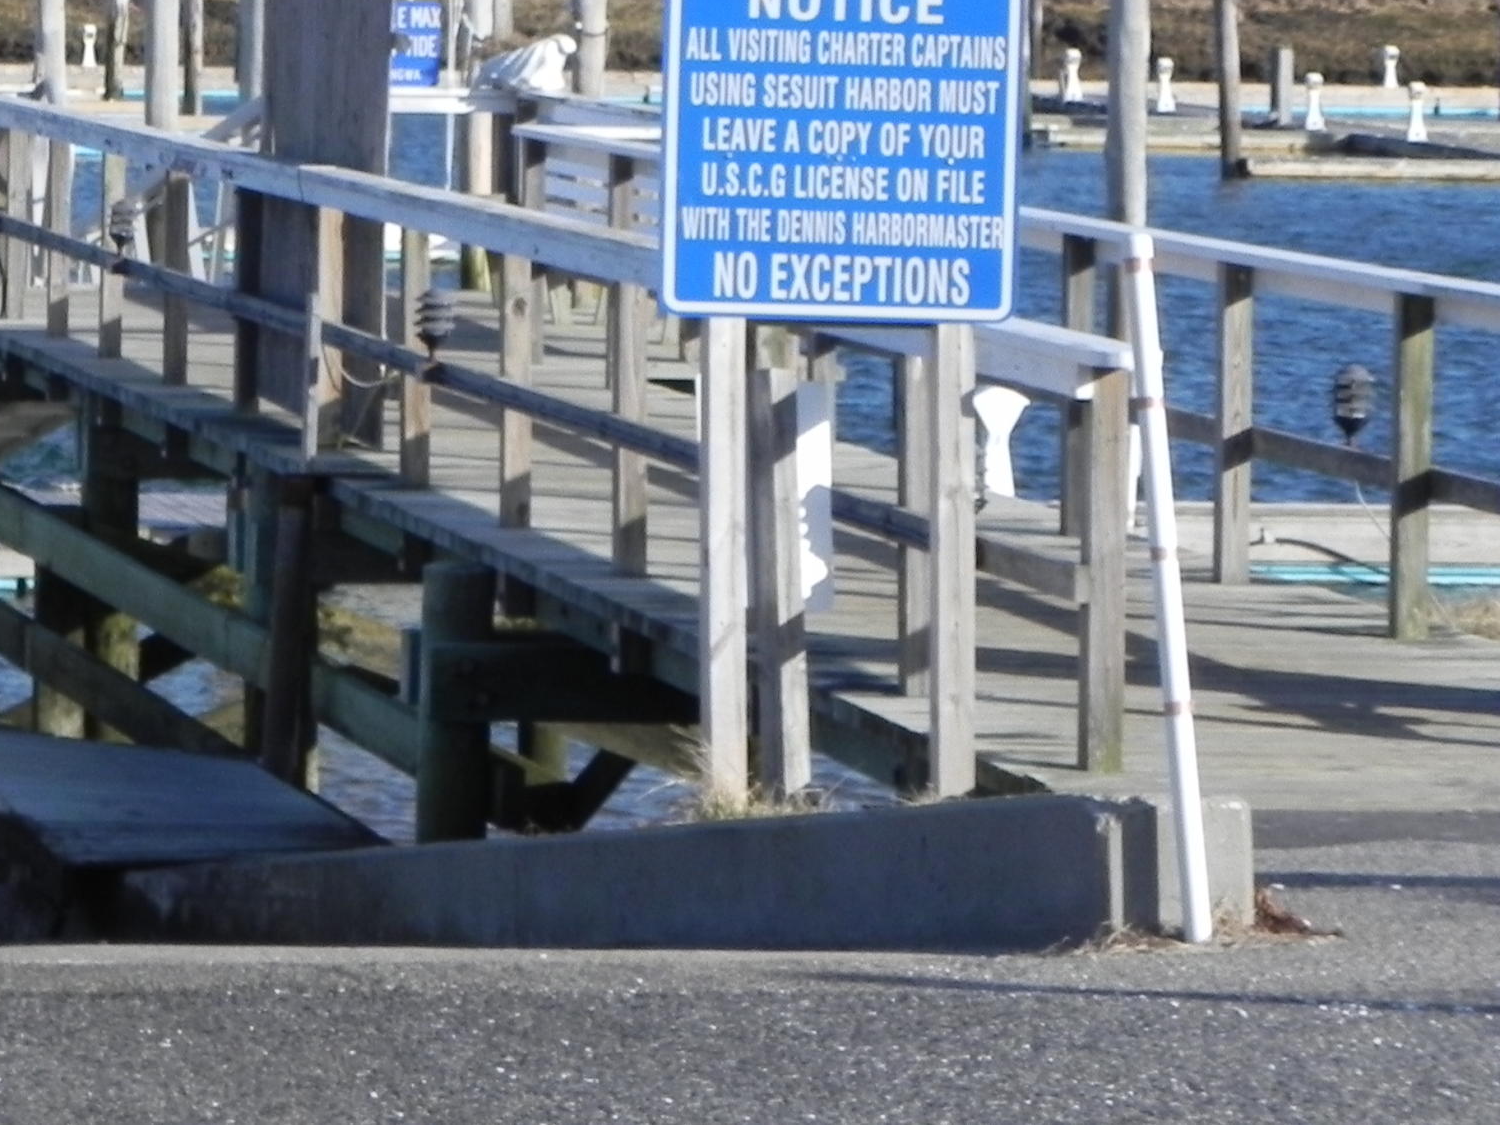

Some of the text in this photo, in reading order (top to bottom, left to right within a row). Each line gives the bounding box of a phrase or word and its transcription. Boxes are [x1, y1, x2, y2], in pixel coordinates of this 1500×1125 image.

[410, 6, 441, 29] MAX
[686, 27, 1006, 70] ALL VISITING CHARTER CAPTAINS
[691, 71, 1000, 114] USING SESUIT HARBOR MUST
[702, 117, 985, 159] LEAVE A COPY OF YOUR
[701, 162, 985, 204] U.S.C.G LICENSE ON FILE
[683, 207, 1004, 250] WITH THE DENNIS HARBORMASTER
[713, 251, 971, 305] NO EXCEPTIONS
